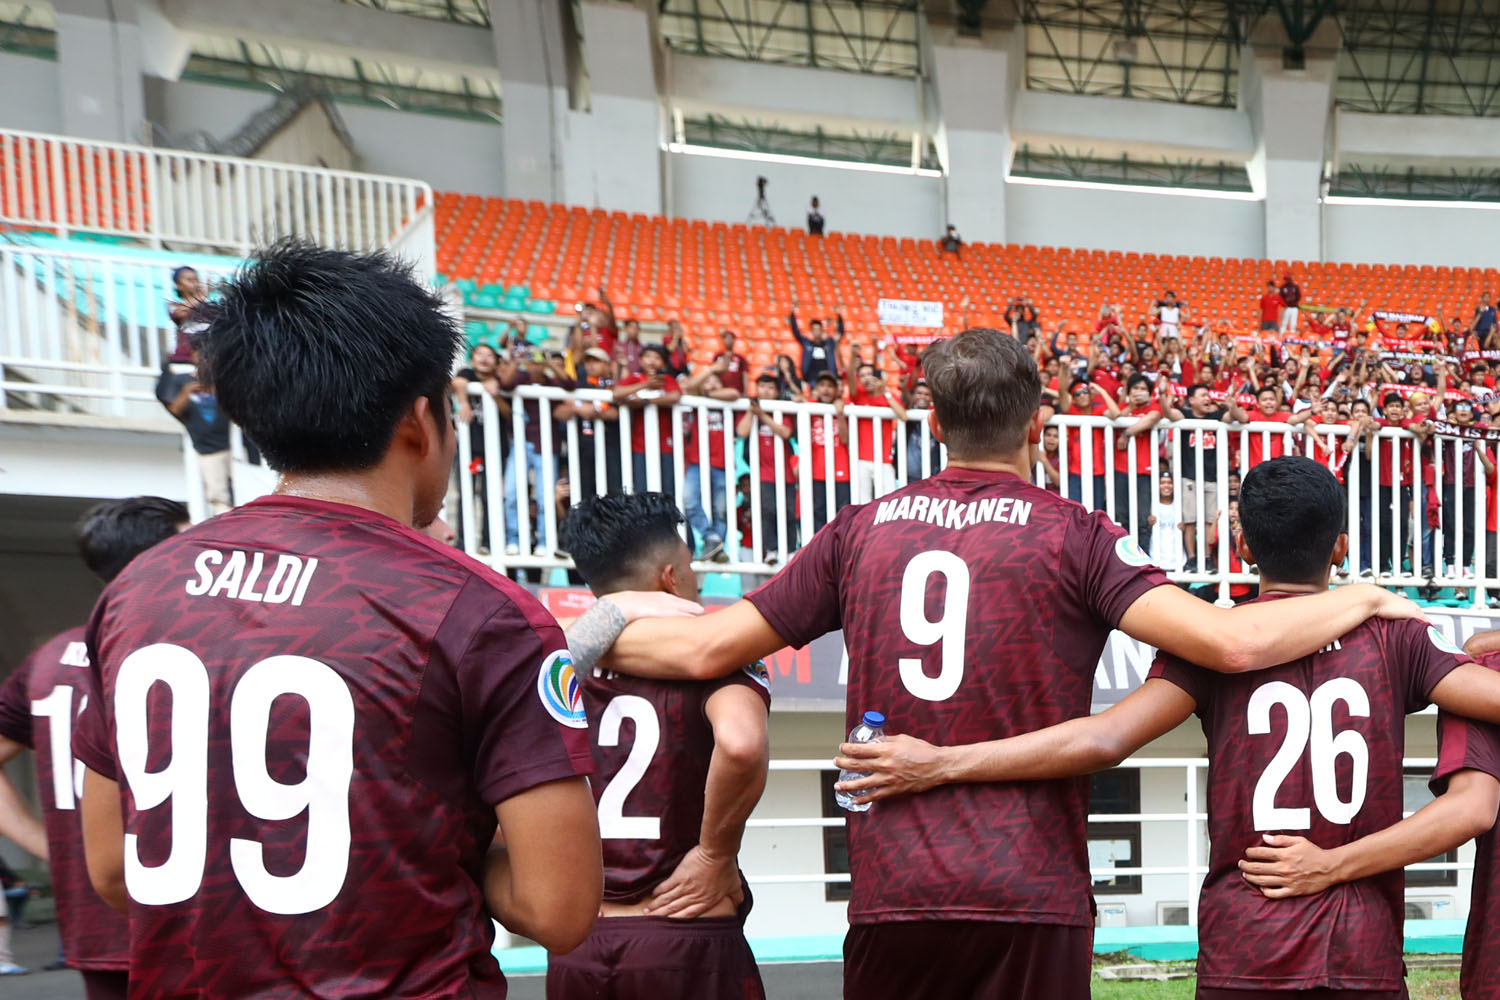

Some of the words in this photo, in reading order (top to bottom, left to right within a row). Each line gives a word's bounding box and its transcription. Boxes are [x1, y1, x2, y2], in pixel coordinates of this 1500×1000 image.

[186, 550, 319, 606] SALDI
[873, 495, 1032, 530] MARKKANEN
[898, 550, 970, 702] 9
[31, 685, 88, 810] 1
[114, 643, 355, 915] 99
[598, 695, 661, 840] 2
[1247, 677, 1370, 832] 26
